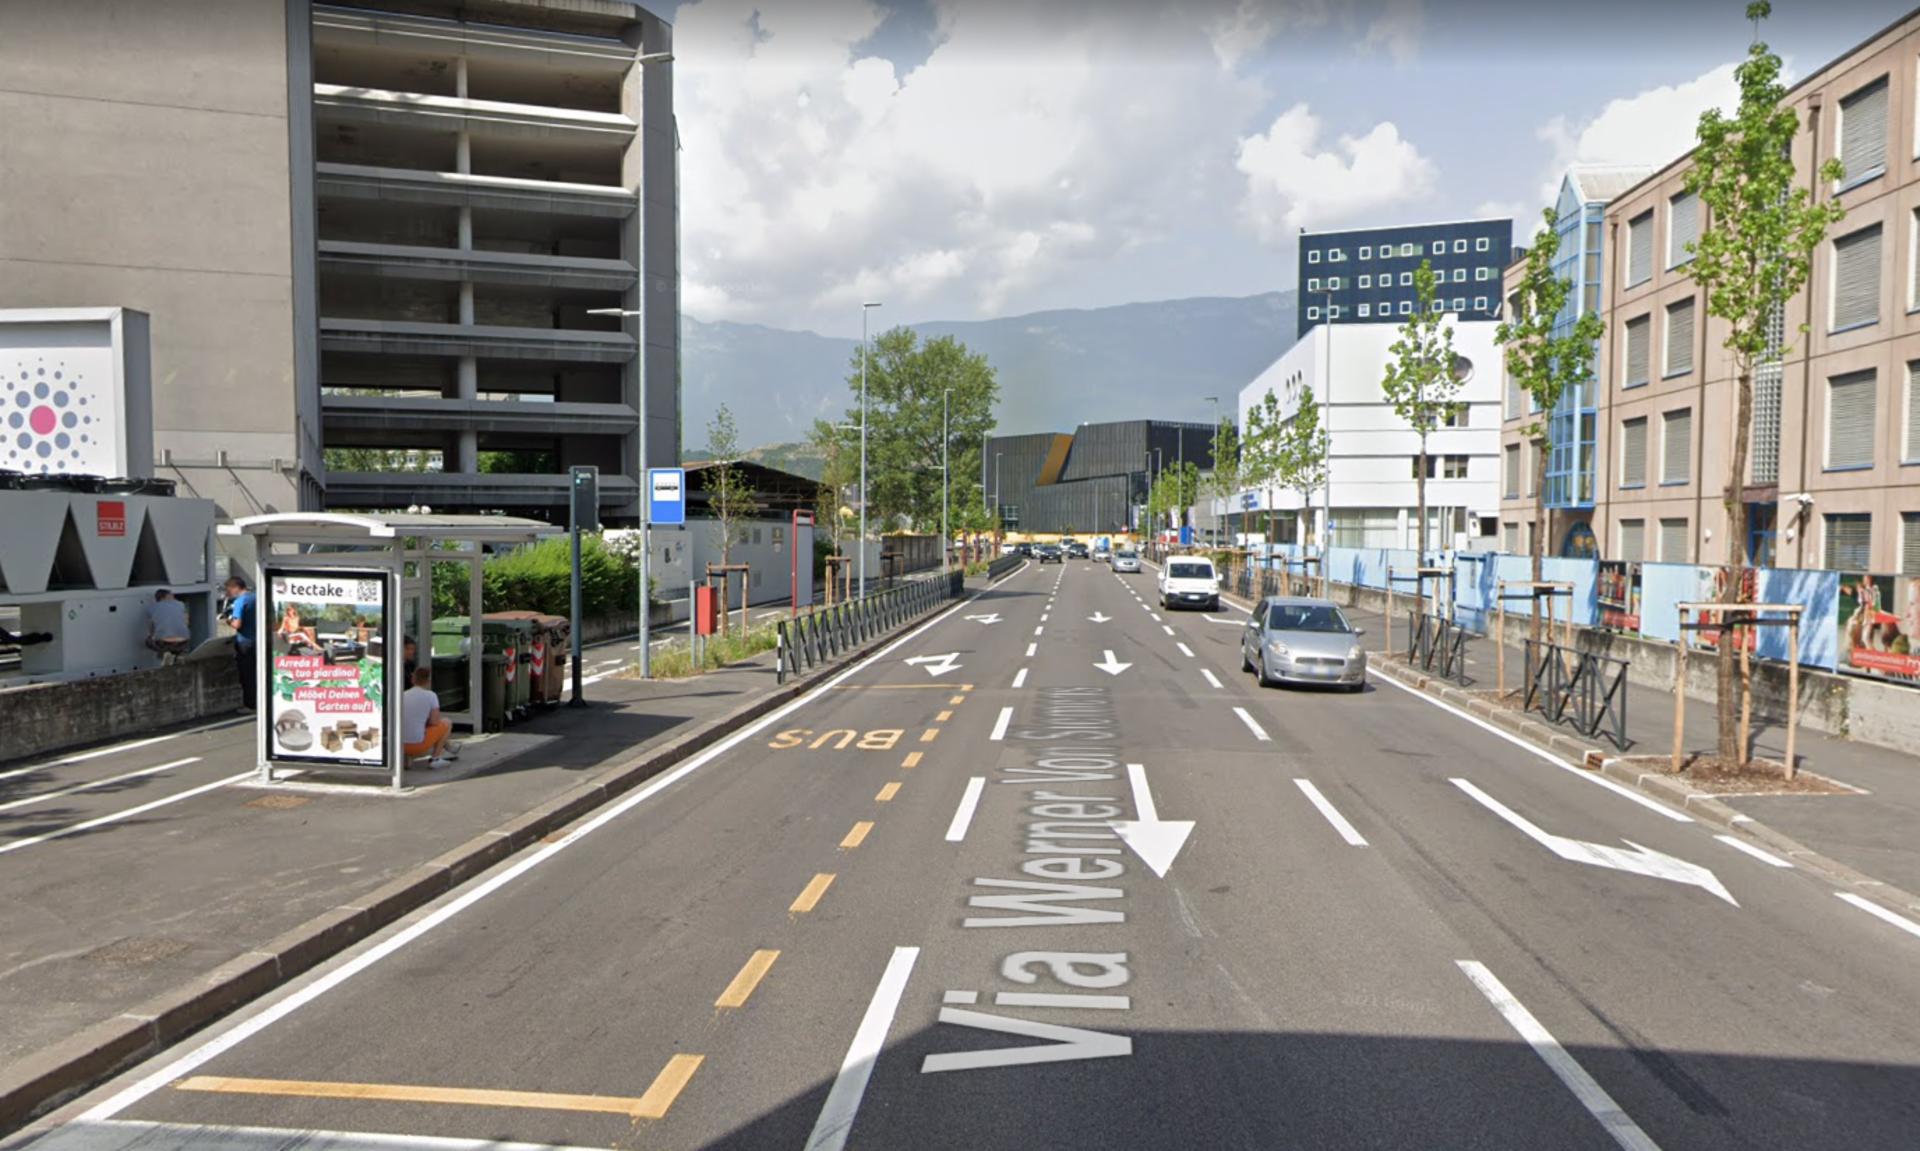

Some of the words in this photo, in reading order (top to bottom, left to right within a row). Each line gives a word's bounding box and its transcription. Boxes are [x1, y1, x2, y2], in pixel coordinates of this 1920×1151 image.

[295, 669, 310, 677] tuo
[318, 701, 350, 710] Garten
[768, 728, 905, 750] BUS
